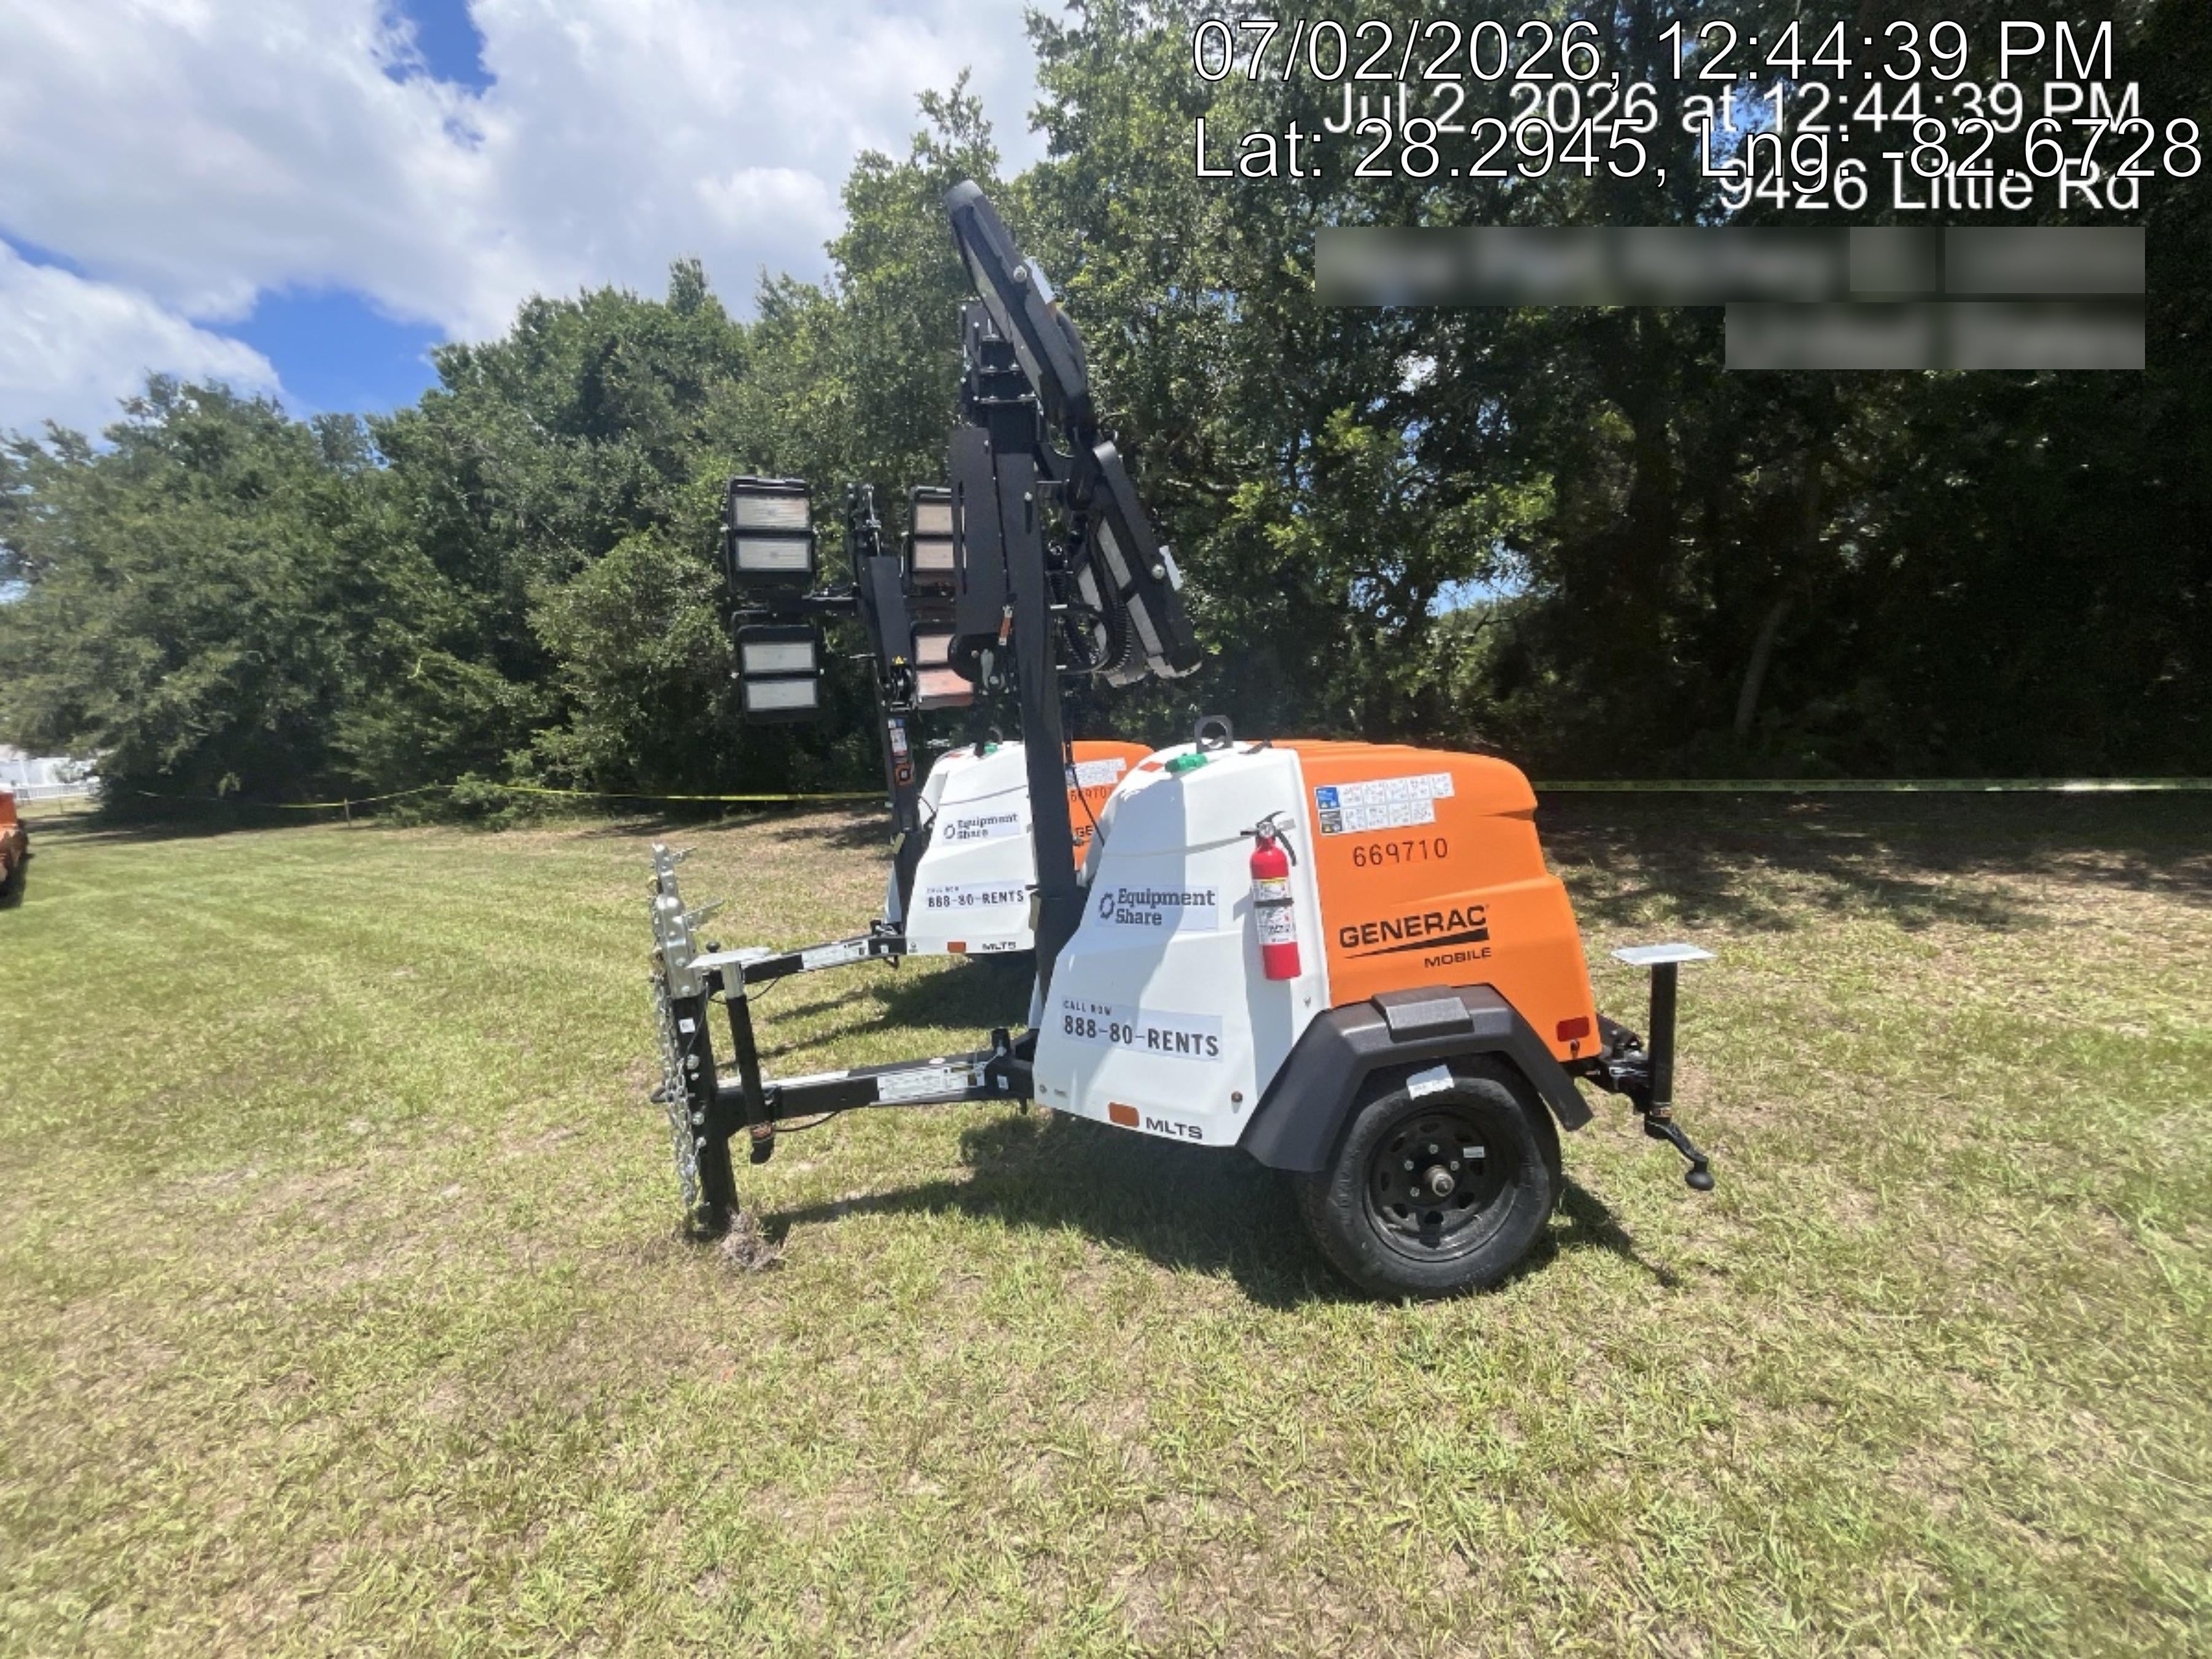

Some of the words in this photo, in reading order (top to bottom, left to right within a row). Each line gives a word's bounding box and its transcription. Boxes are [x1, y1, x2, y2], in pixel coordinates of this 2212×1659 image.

[1353, 837, 1448, 868] 669710
[1117, 888, 1215, 909] Equipment
[1115, 908, 1163, 925] Share
[1339, 904, 1487, 948] GENERAC
[1424, 947, 1492, 968] MOBILE
[1063, 1000, 1086, 1013] CALL
[1064, 1014, 1219, 1057] 888-80-RENTS
[1146, 1116, 1203, 1140] MLTS
